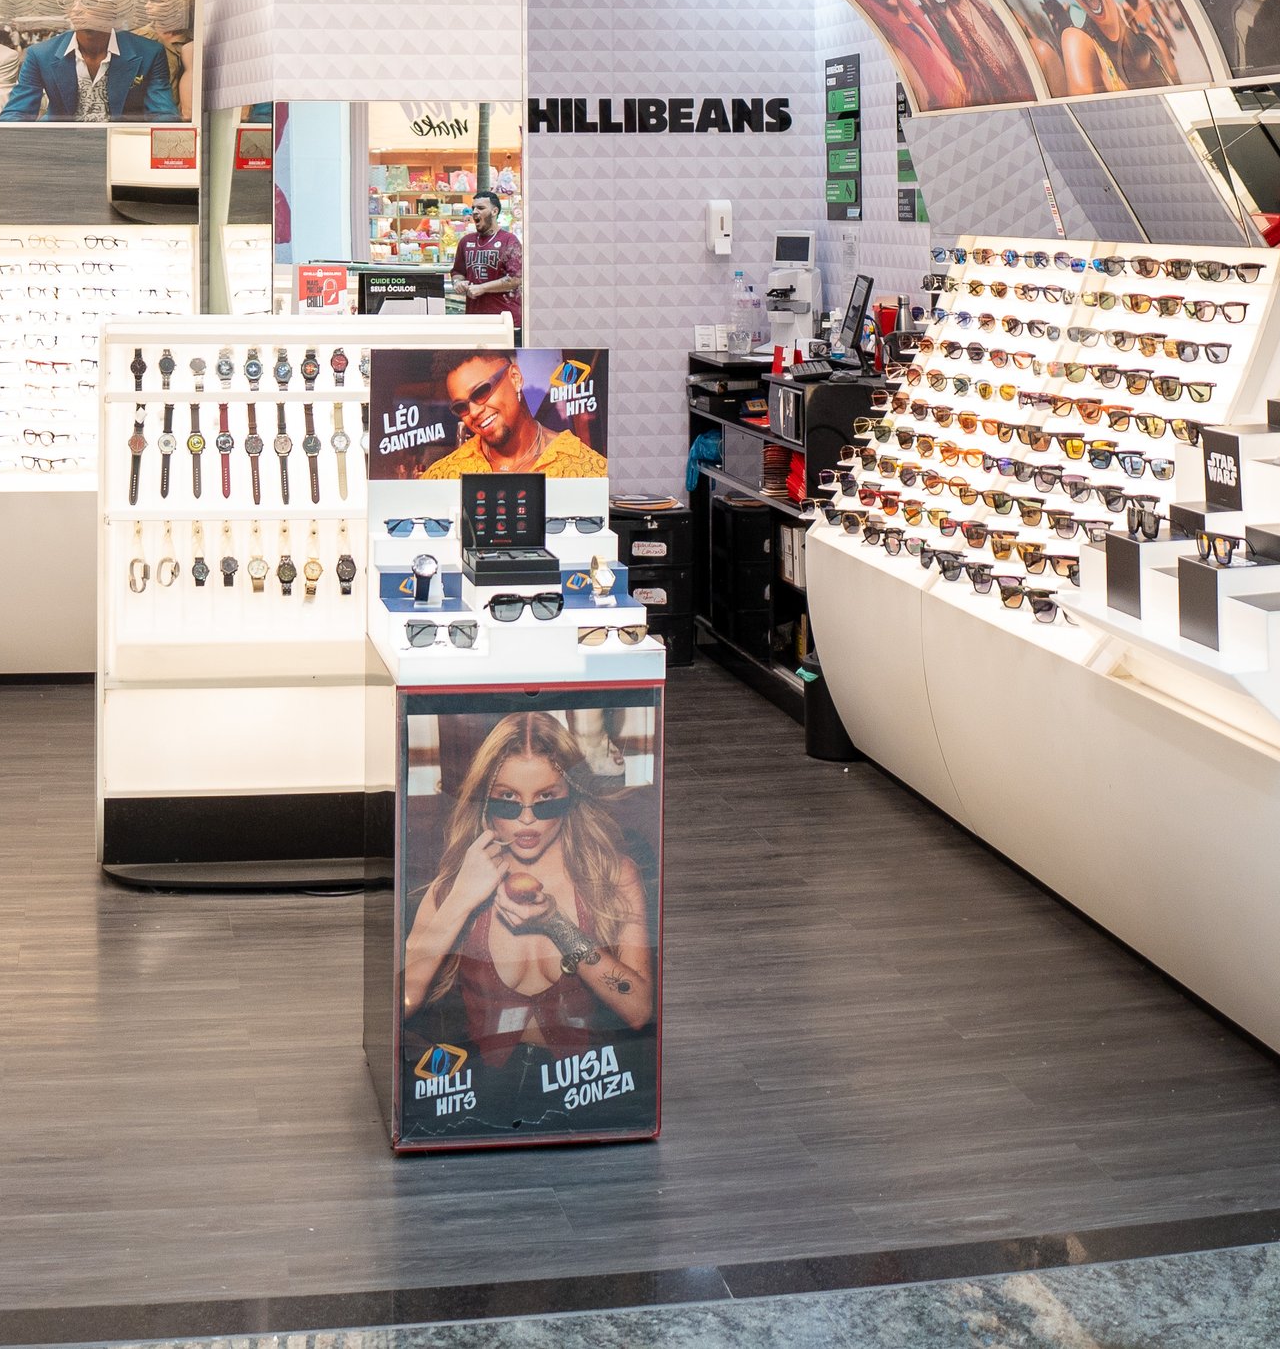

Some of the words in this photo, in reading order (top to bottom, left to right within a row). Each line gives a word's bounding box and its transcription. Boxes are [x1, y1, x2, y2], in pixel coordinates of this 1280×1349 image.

[527, 97, 793, 134] HILLIBEANS
[387, 284, 417, 292] ÓCULOS!
[549, 379, 594, 404] CHILLI
[382, 403, 420, 435] LÉO
[565, 396, 597, 417] HITS
[378, 422, 446, 455] SANTANA
[1207, 451, 1237, 472] STAR
[1207, 467, 1238, 488] WARS
[541, 1045, 619, 1093] LUISA
[414, 1068, 472, 1100] CHILLI
[563, 1071, 635, 1110] SONZA
[436, 1091, 477, 1116] HITS
